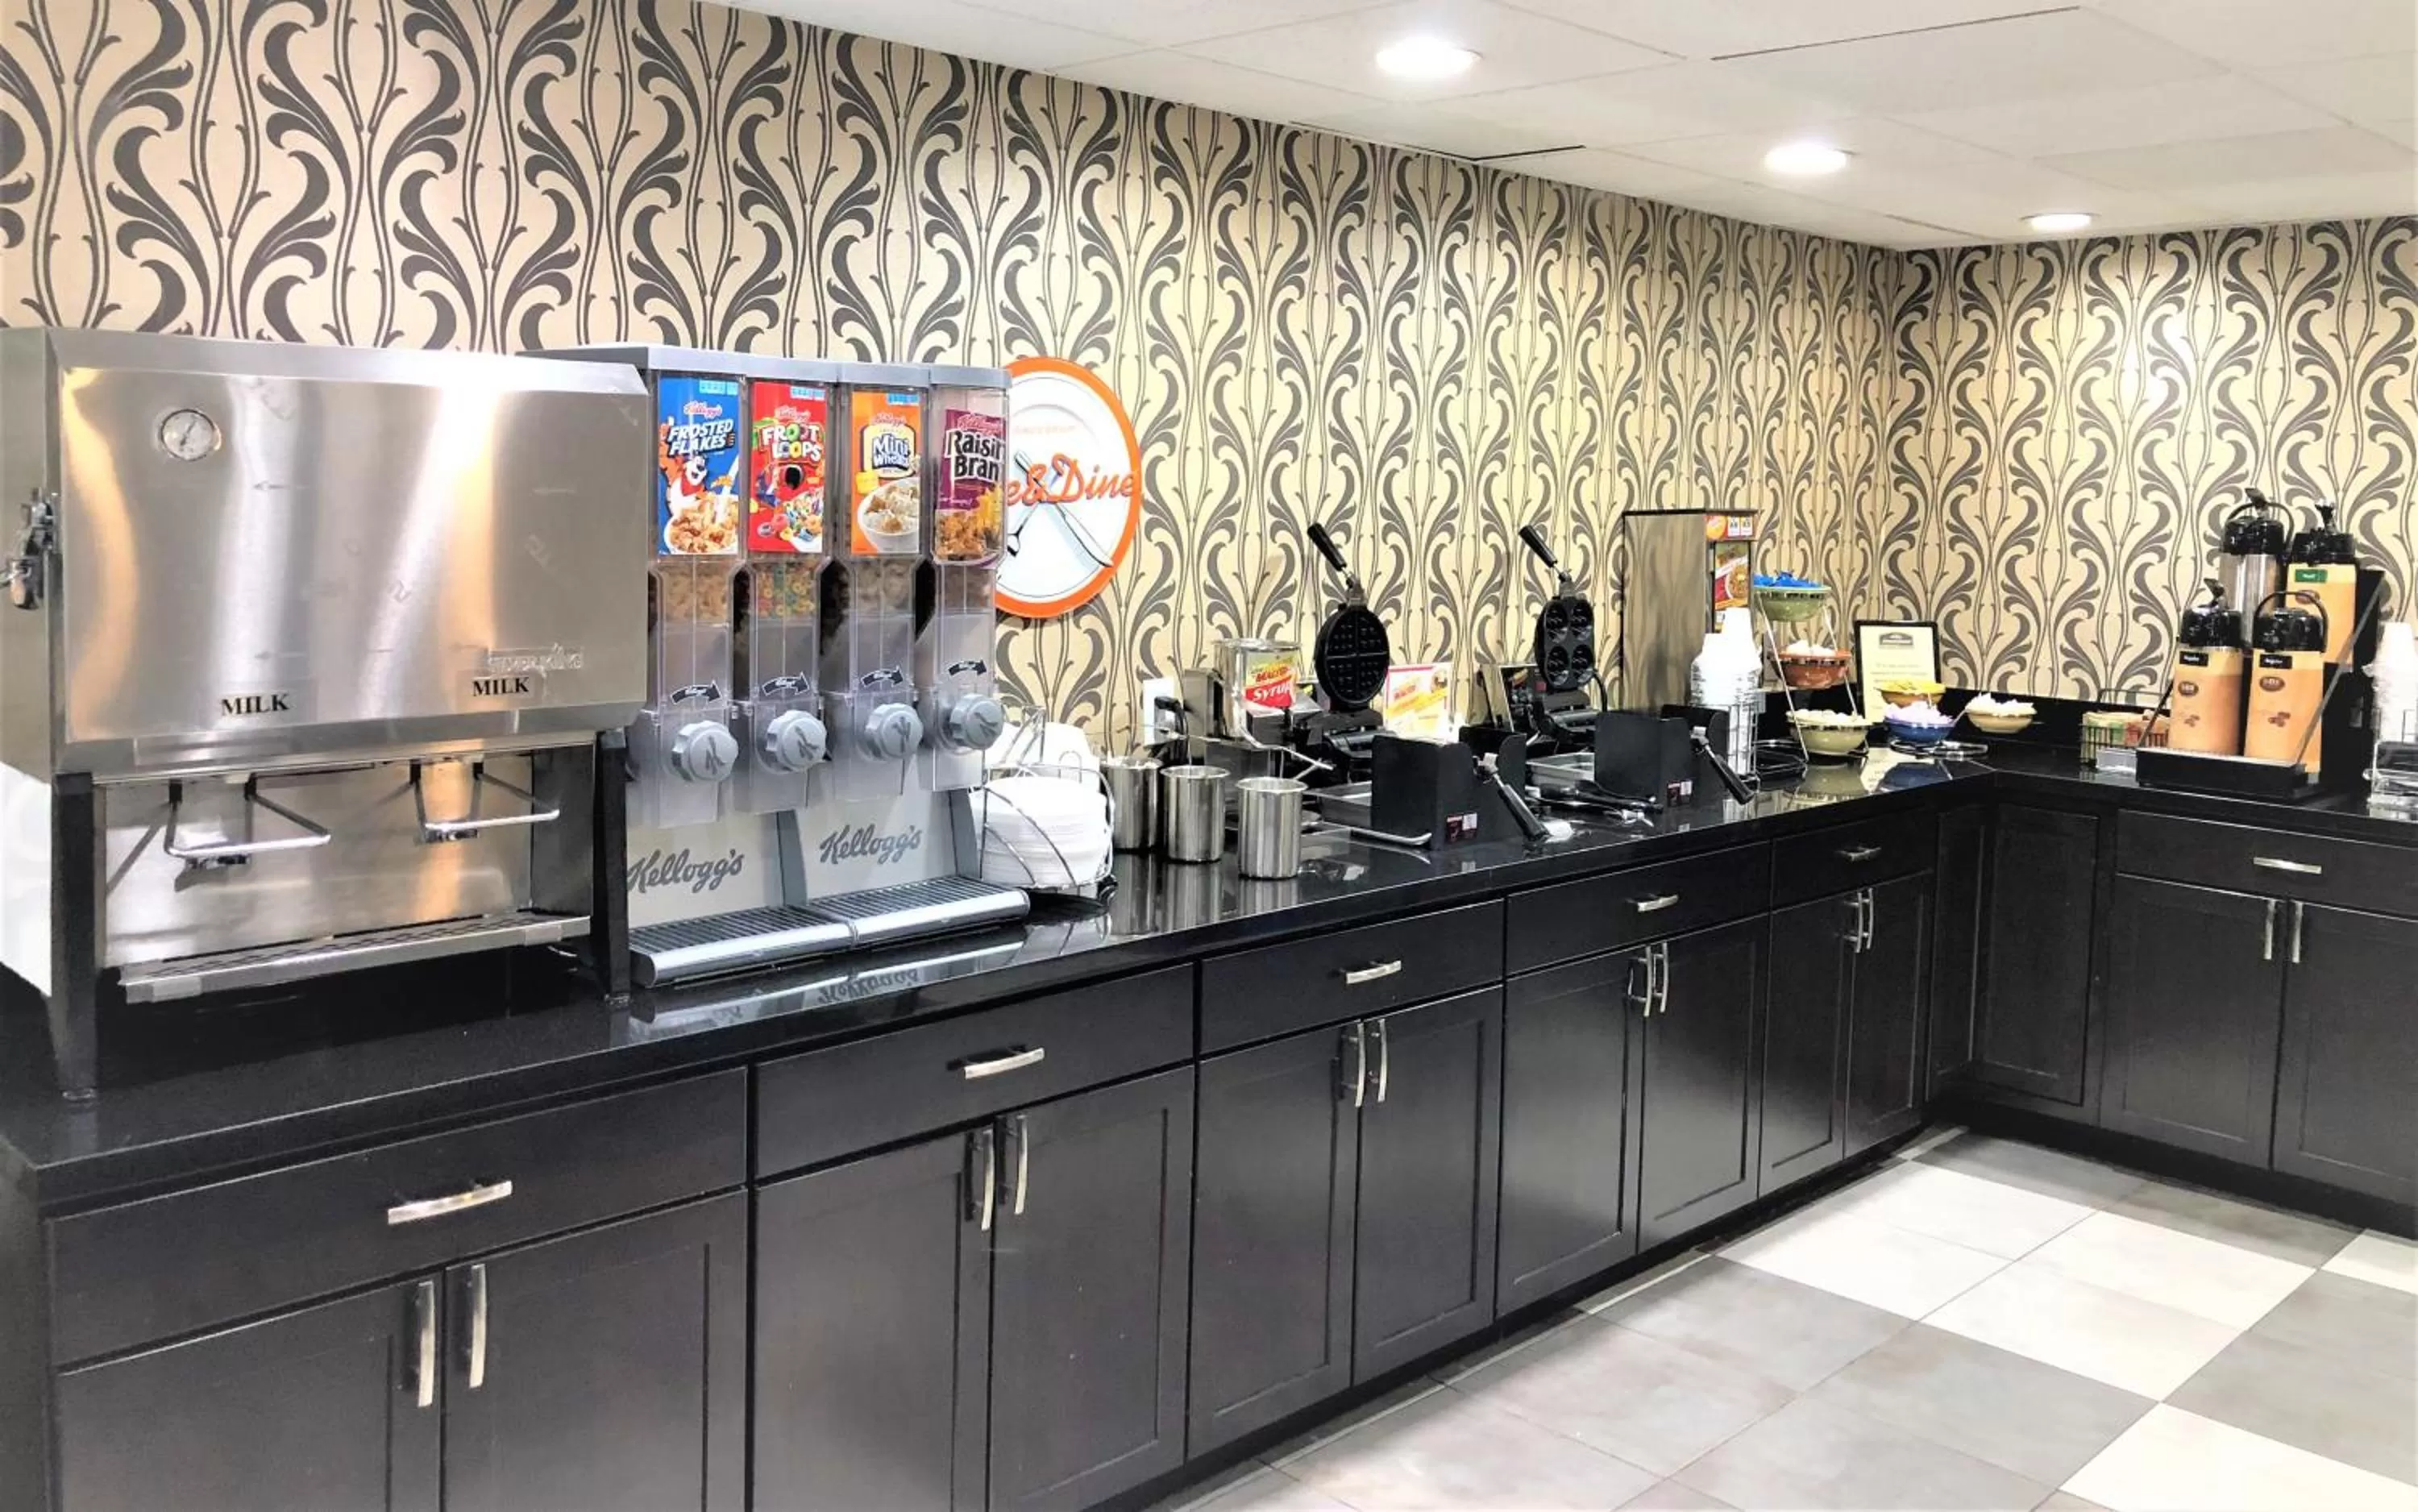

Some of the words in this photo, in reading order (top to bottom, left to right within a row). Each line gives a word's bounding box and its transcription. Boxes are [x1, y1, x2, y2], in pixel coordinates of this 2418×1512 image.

[667, 419, 734, 442] FROSTED
[669, 435, 726, 456] FLAKES
[772, 441, 821, 462] LOOPS
[953, 455, 999, 482] Bran
[473, 676, 530, 697] MILK
[221, 693, 290, 717] MILK
[820, 823, 922, 864] Kellogg's
[626, 848, 745, 893] Kellogg's
